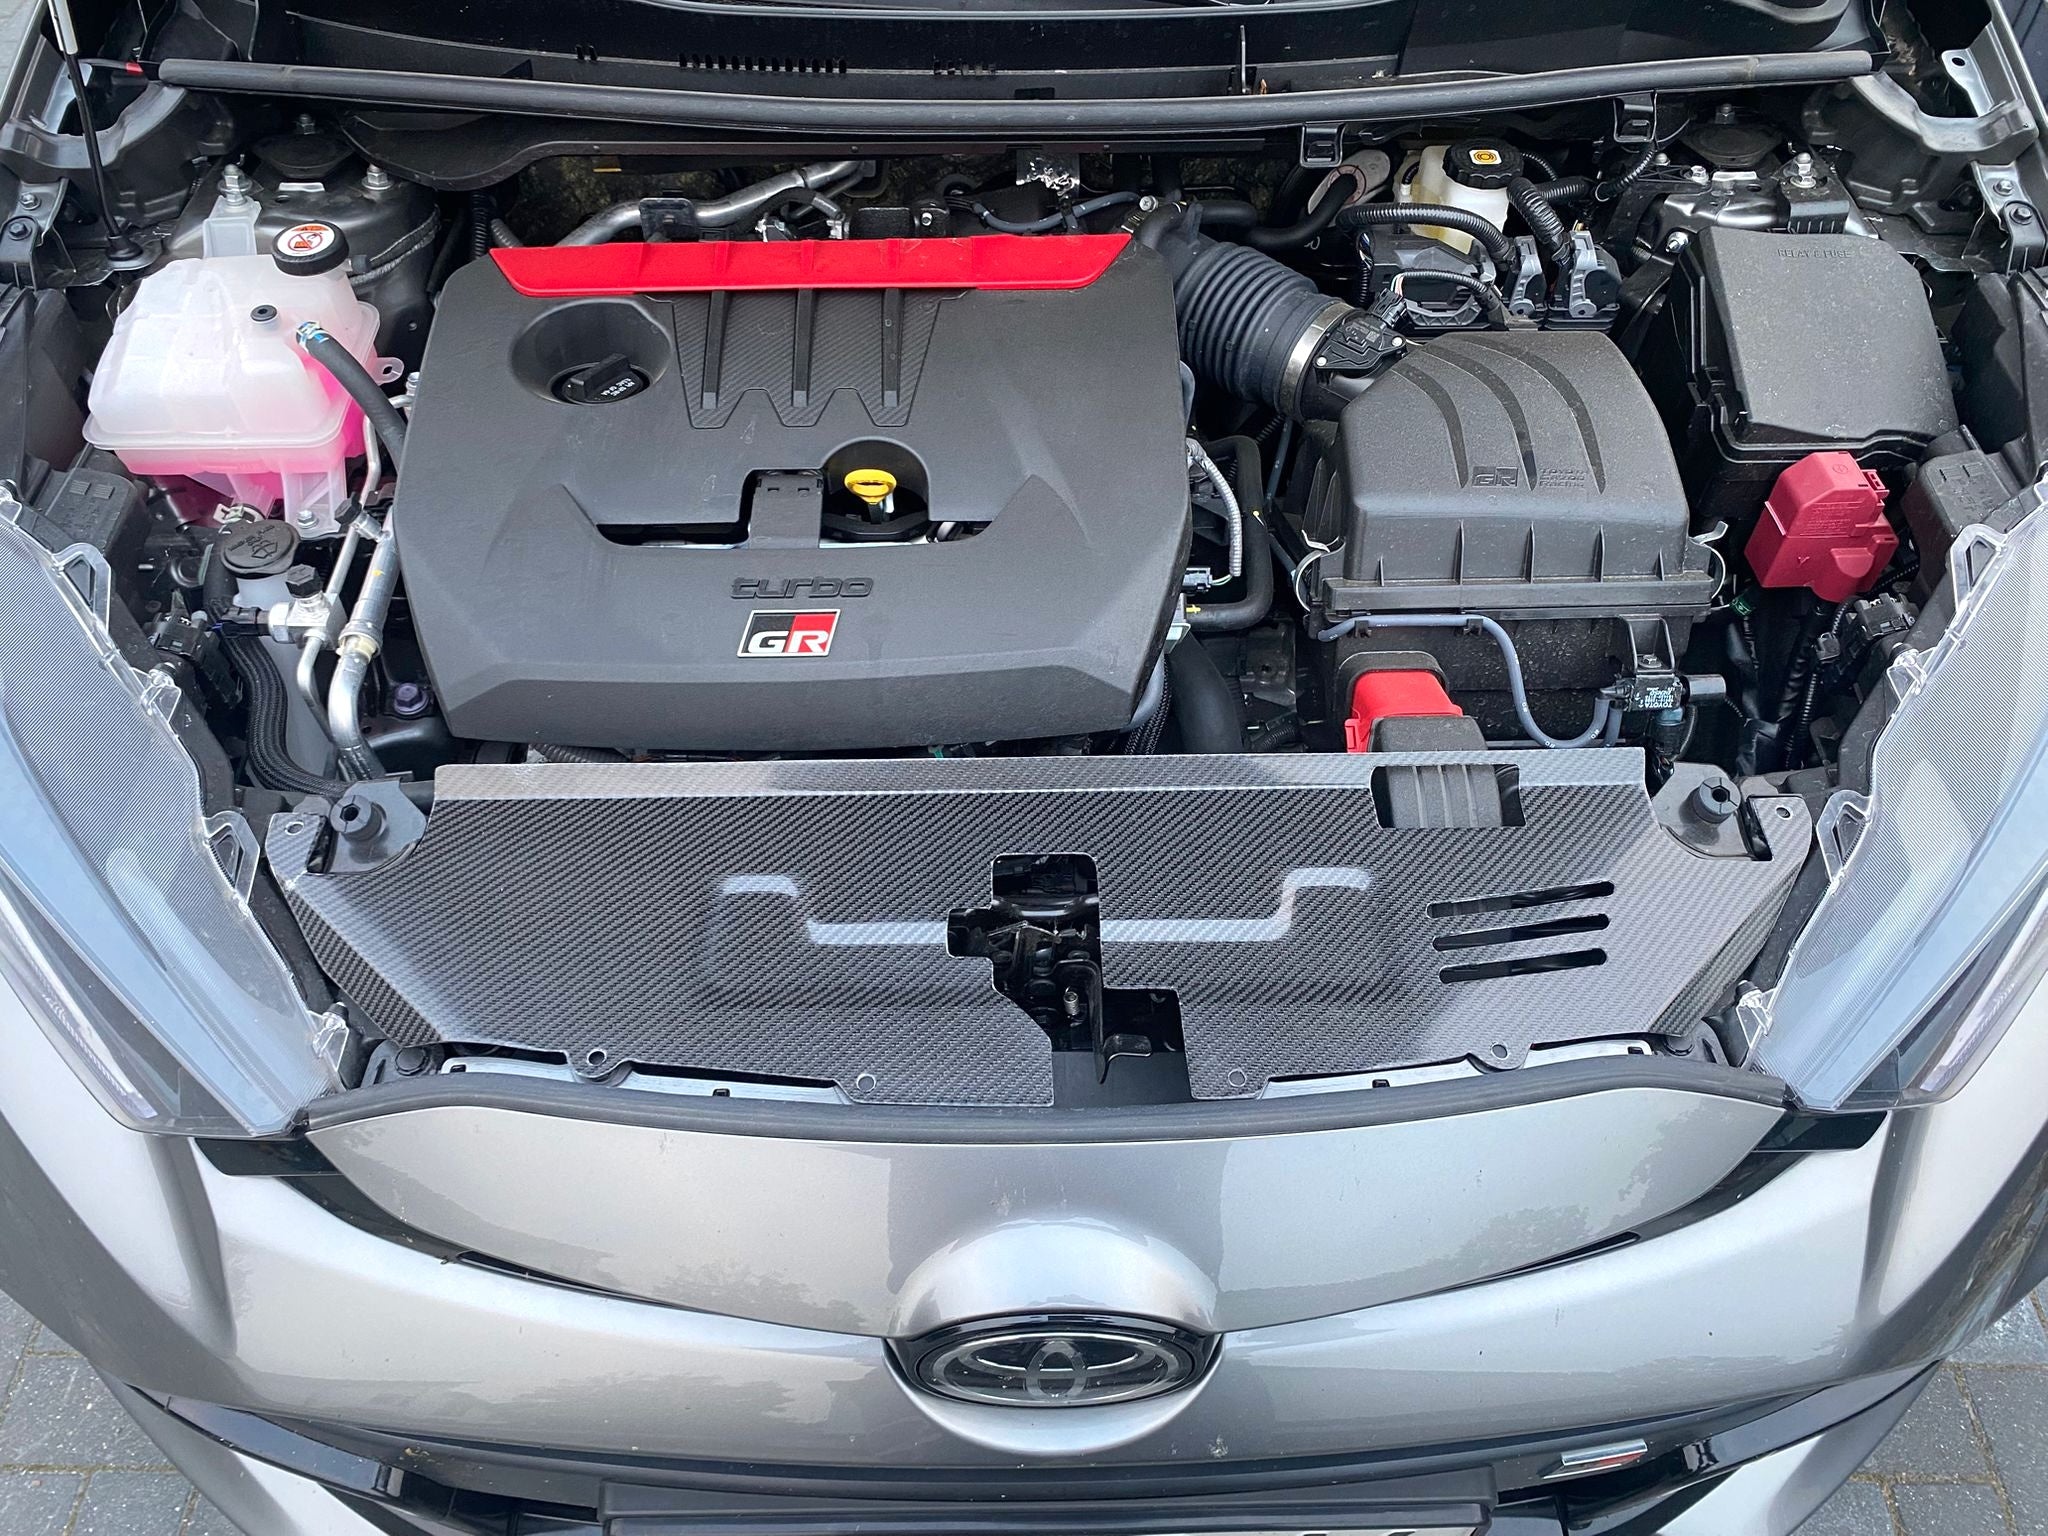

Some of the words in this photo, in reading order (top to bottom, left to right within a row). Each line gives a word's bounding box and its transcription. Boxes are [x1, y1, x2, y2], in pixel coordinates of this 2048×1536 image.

[1777, 248, 1810, 258] RELAY
[1823, 249, 1851, 259] FUSE
[1474, 472, 1518, 488] GR
[731, 576, 874, 599] turbo
[748, 630, 829, 653] GR
